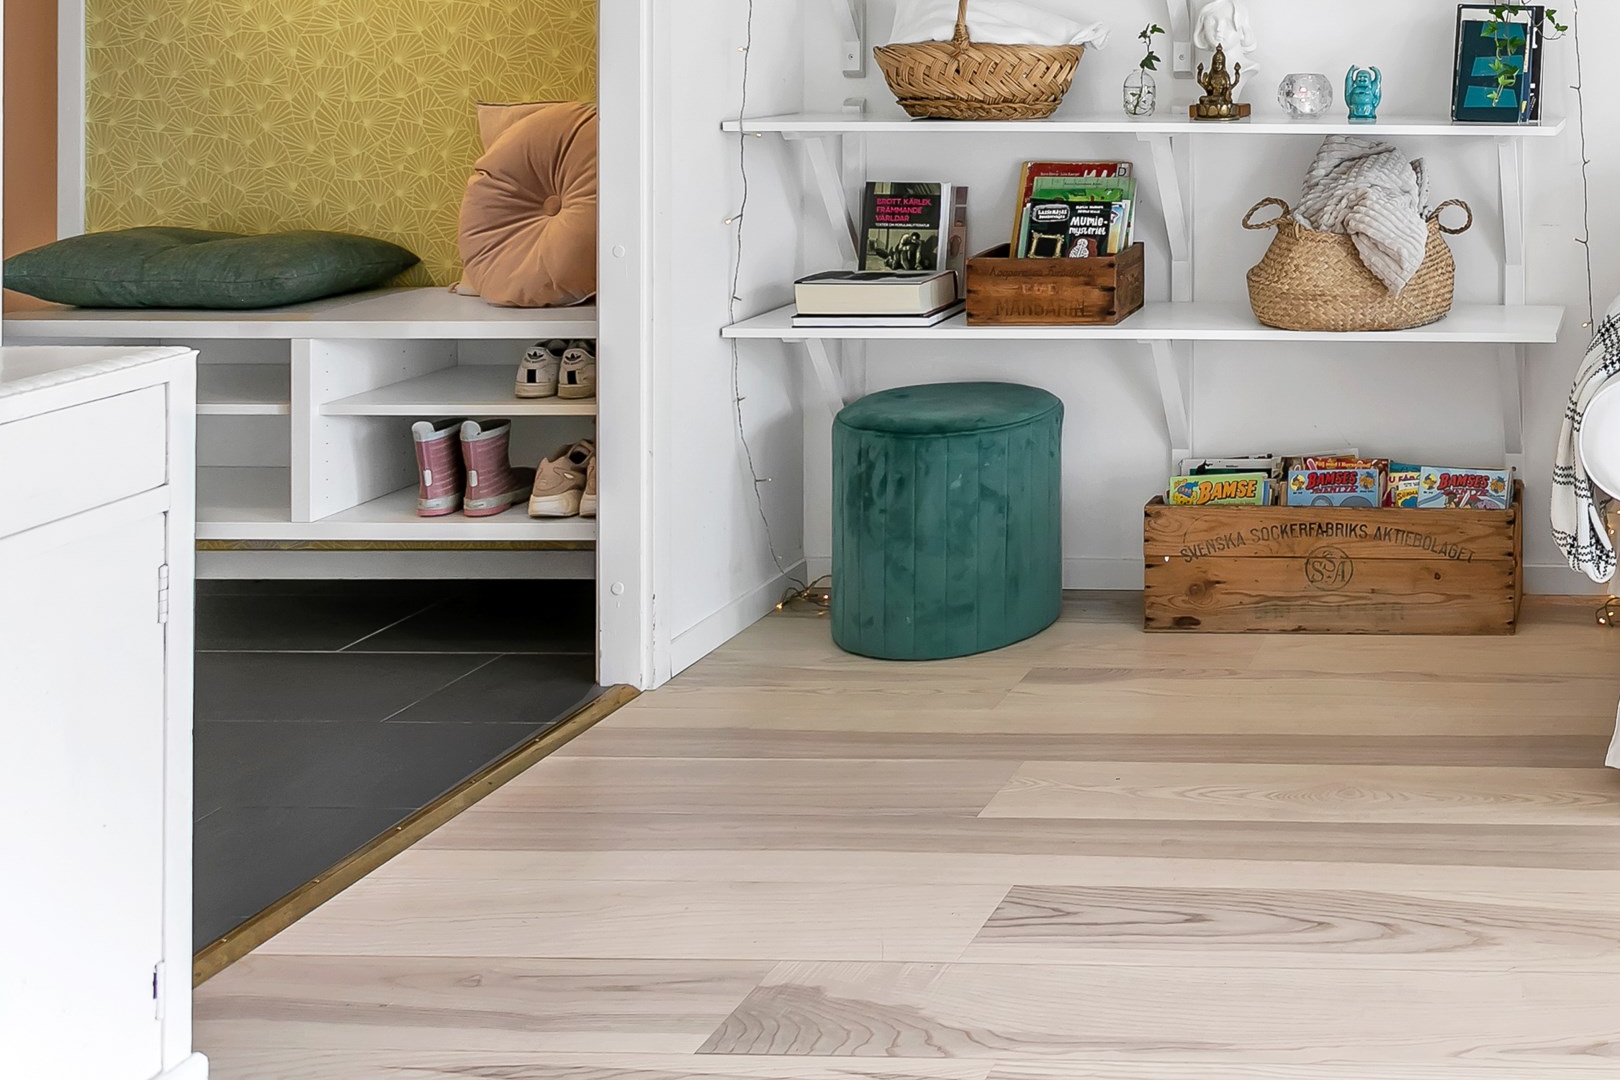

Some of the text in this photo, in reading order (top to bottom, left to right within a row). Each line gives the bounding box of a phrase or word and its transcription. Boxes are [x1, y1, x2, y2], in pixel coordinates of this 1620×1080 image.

[875, 214, 910, 222] VÄRLDAR
[876, 206, 923, 214] FRÄMMANDE
[1068, 227, 1107, 237] mysteriet
[1305, 471, 1359, 490] BAMSES
[1436, 473, 1490, 490] BAMSES
[1197, 479, 1258, 505] BAMSE
[1180, 522, 1476, 564] SVENSKA SOCKERFABRIKS AKTIEBOLAGET
